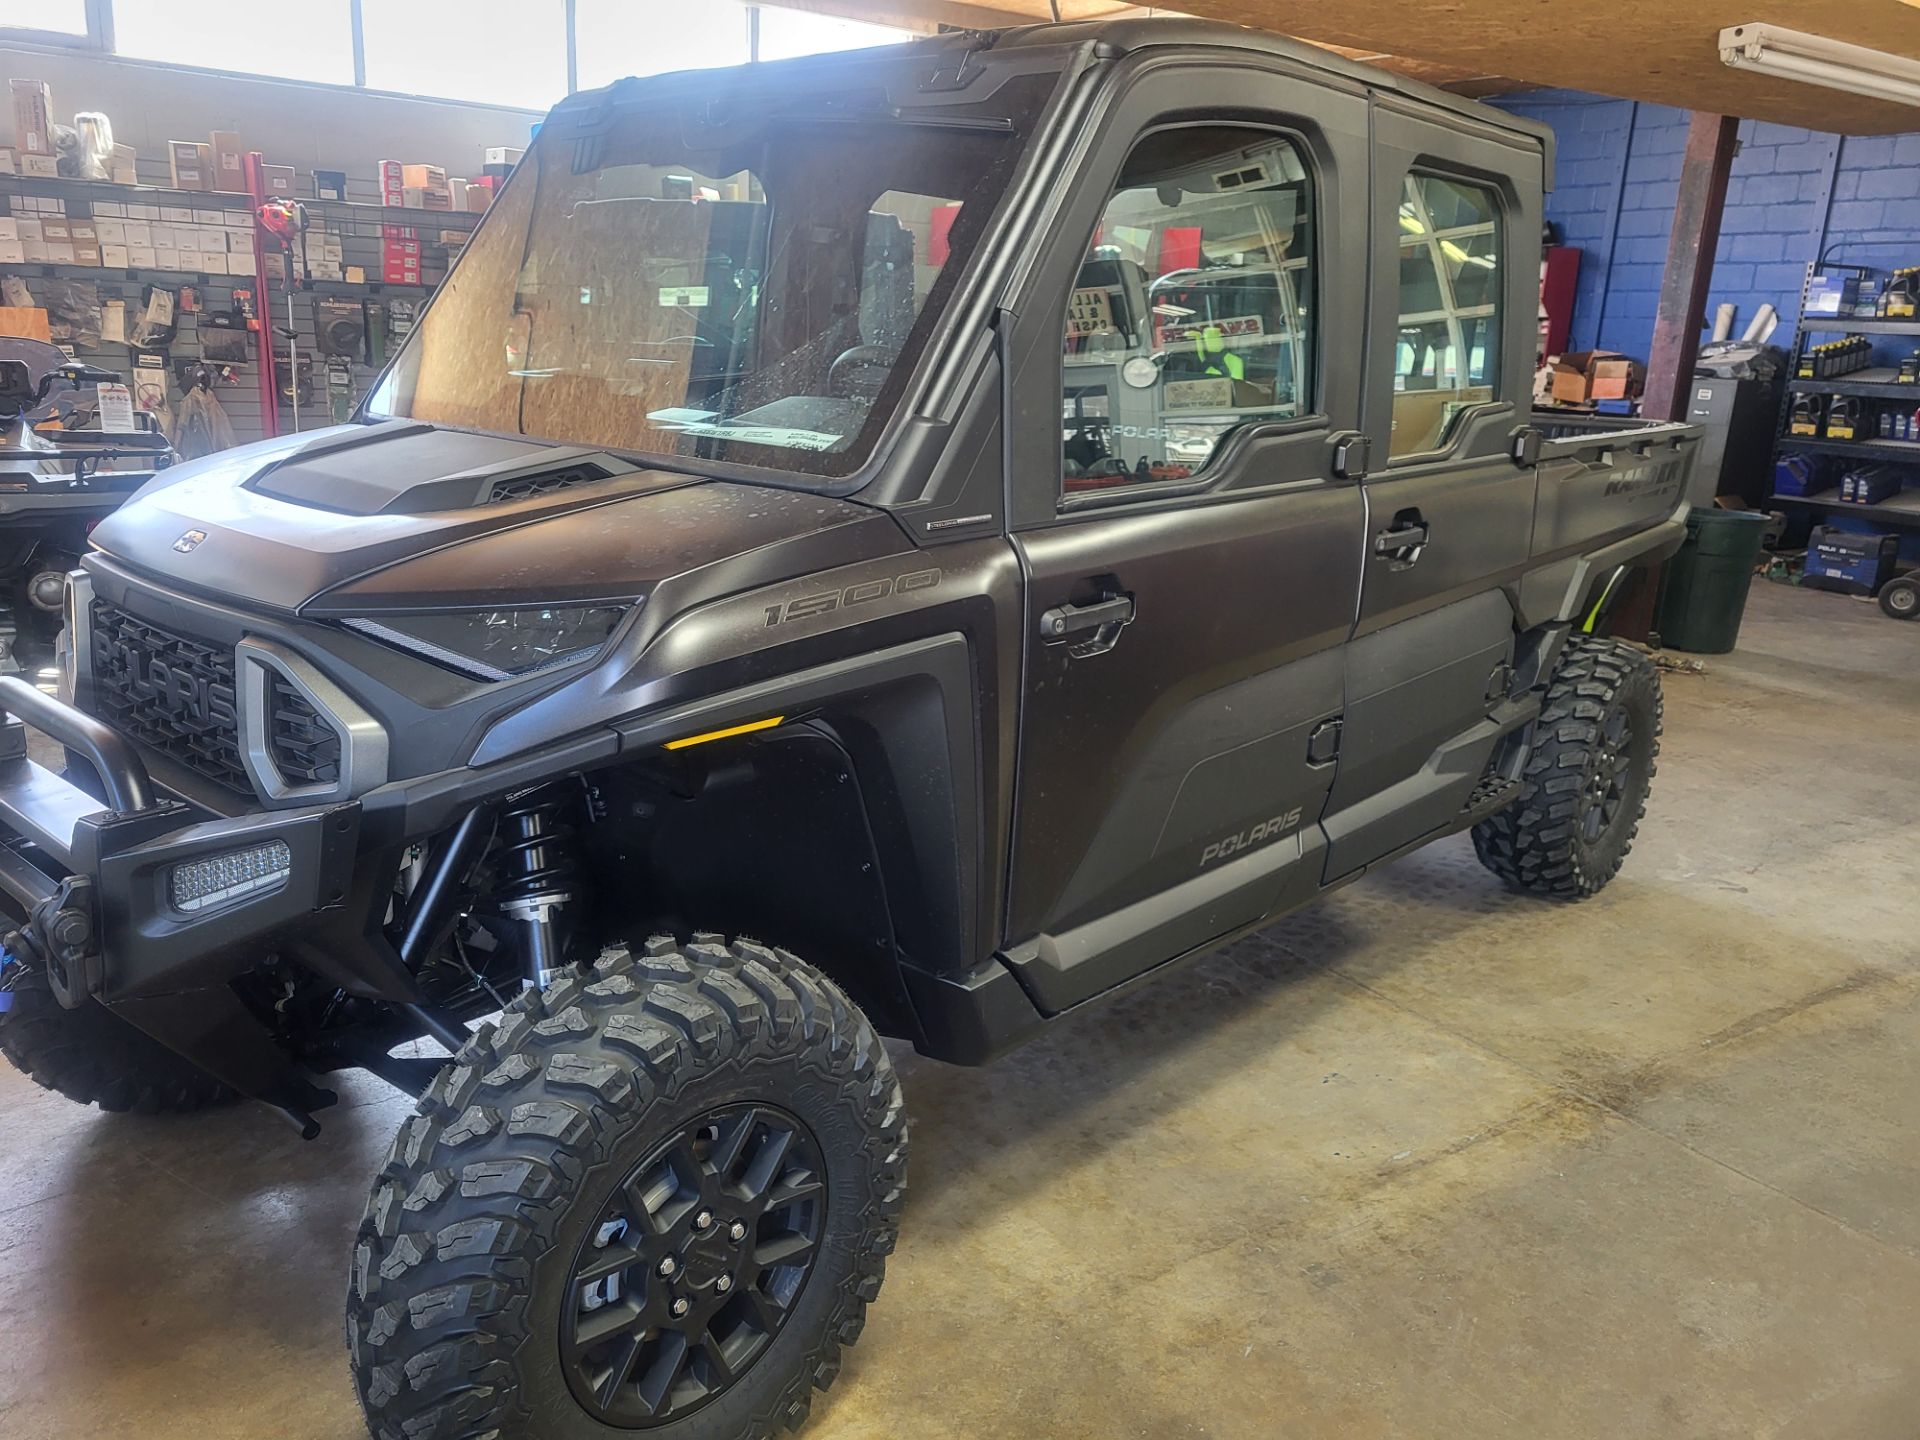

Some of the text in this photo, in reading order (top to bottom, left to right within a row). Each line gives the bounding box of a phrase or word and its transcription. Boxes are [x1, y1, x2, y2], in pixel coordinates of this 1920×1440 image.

[762, 567, 943, 628] 1500
[93, 626, 237, 730] POLARIS
[1199, 805, 1304, 867] POLARIS
